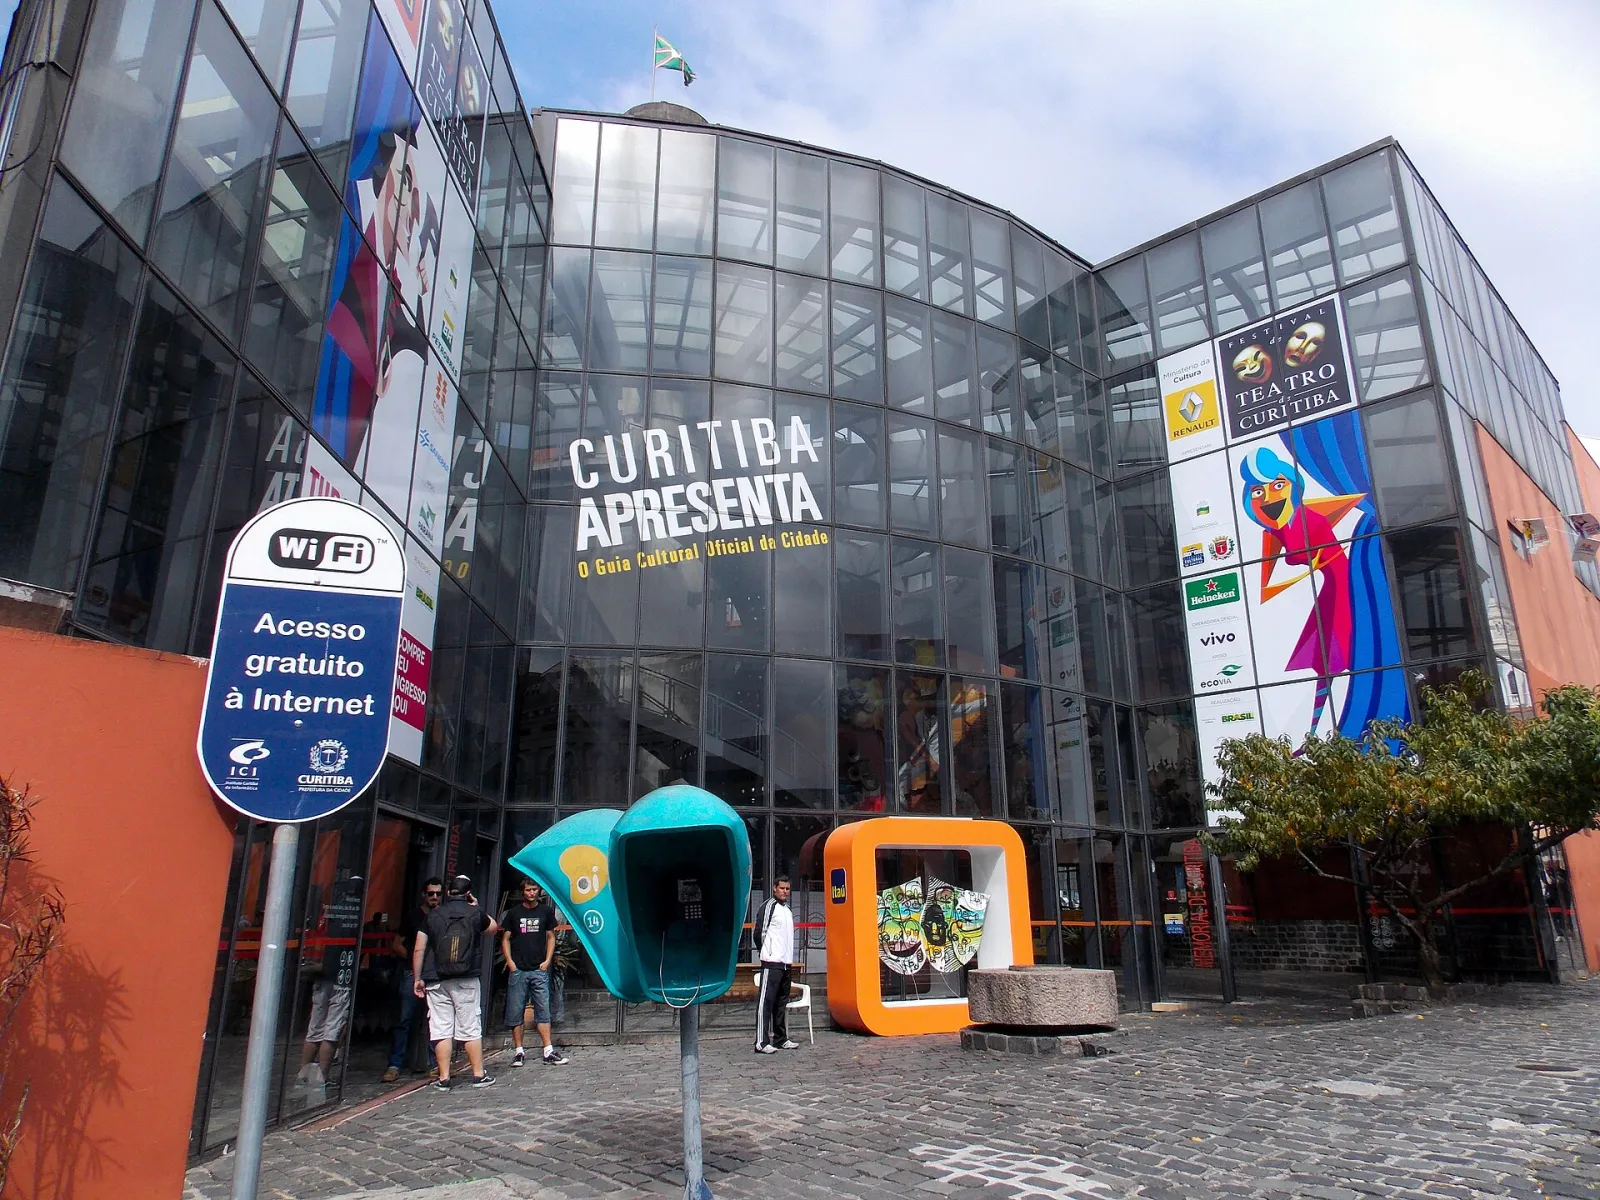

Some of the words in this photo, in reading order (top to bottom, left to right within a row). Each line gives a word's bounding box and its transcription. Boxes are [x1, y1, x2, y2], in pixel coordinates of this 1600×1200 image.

[430, 43, 476, 166] TEATRO
[424, 82, 473, 199] CURITIBA
[1228, 308, 1326, 349] FESTIVAL
[431, 332, 458, 378] PETROBRAS
[1163, 362, 1199, 380] Ministério
[1200, 357, 1211, 366] da
[1173, 369, 1202, 384] Cultura
[1235, 362, 1336, 408] TEATRO
[1238, 388, 1341, 431] CURITIBA
[1172, 418, 1215, 438] RENAULT
[569, 415, 819, 490] CURITIBA
[576, 472, 823, 552] APRESENTA
[578, 561, 588, 579] O
[595, 558, 631, 576] Guia
[637, 543, 699, 569] Cultural
[705, 536, 754, 558] Oficial
[781, 529, 829, 549] Cidade
[1191, 588, 1236, 606] Heineken
[253, 612, 366, 641] Acesso
[1200, 632, 1236, 647] vivo
[245, 654, 364, 679] gratuito
[397, 655, 409, 673] EU
[394, 677, 427, 706] NGRESSO
[1200, 678, 1232, 689] ecoVIA
[224, 687, 243, 710] à
[253, 692, 375, 716] Internet
[393, 696, 409, 715] QUI
[1221, 712, 1255, 724] BRASIL
[230, 767, 257, 777] ICI
[297, 774, 353, 785] CURITIBA
[1182, 838, 1204, 890] CURITIBA
[577, 865, 599, 895] oi
[831, 884, 846, 899] Itaú
[1188, 891, 1207, 906] DE
[587, 917, 600, 929] 14
[1190, 909, 1215, 969] MEMORIAL
